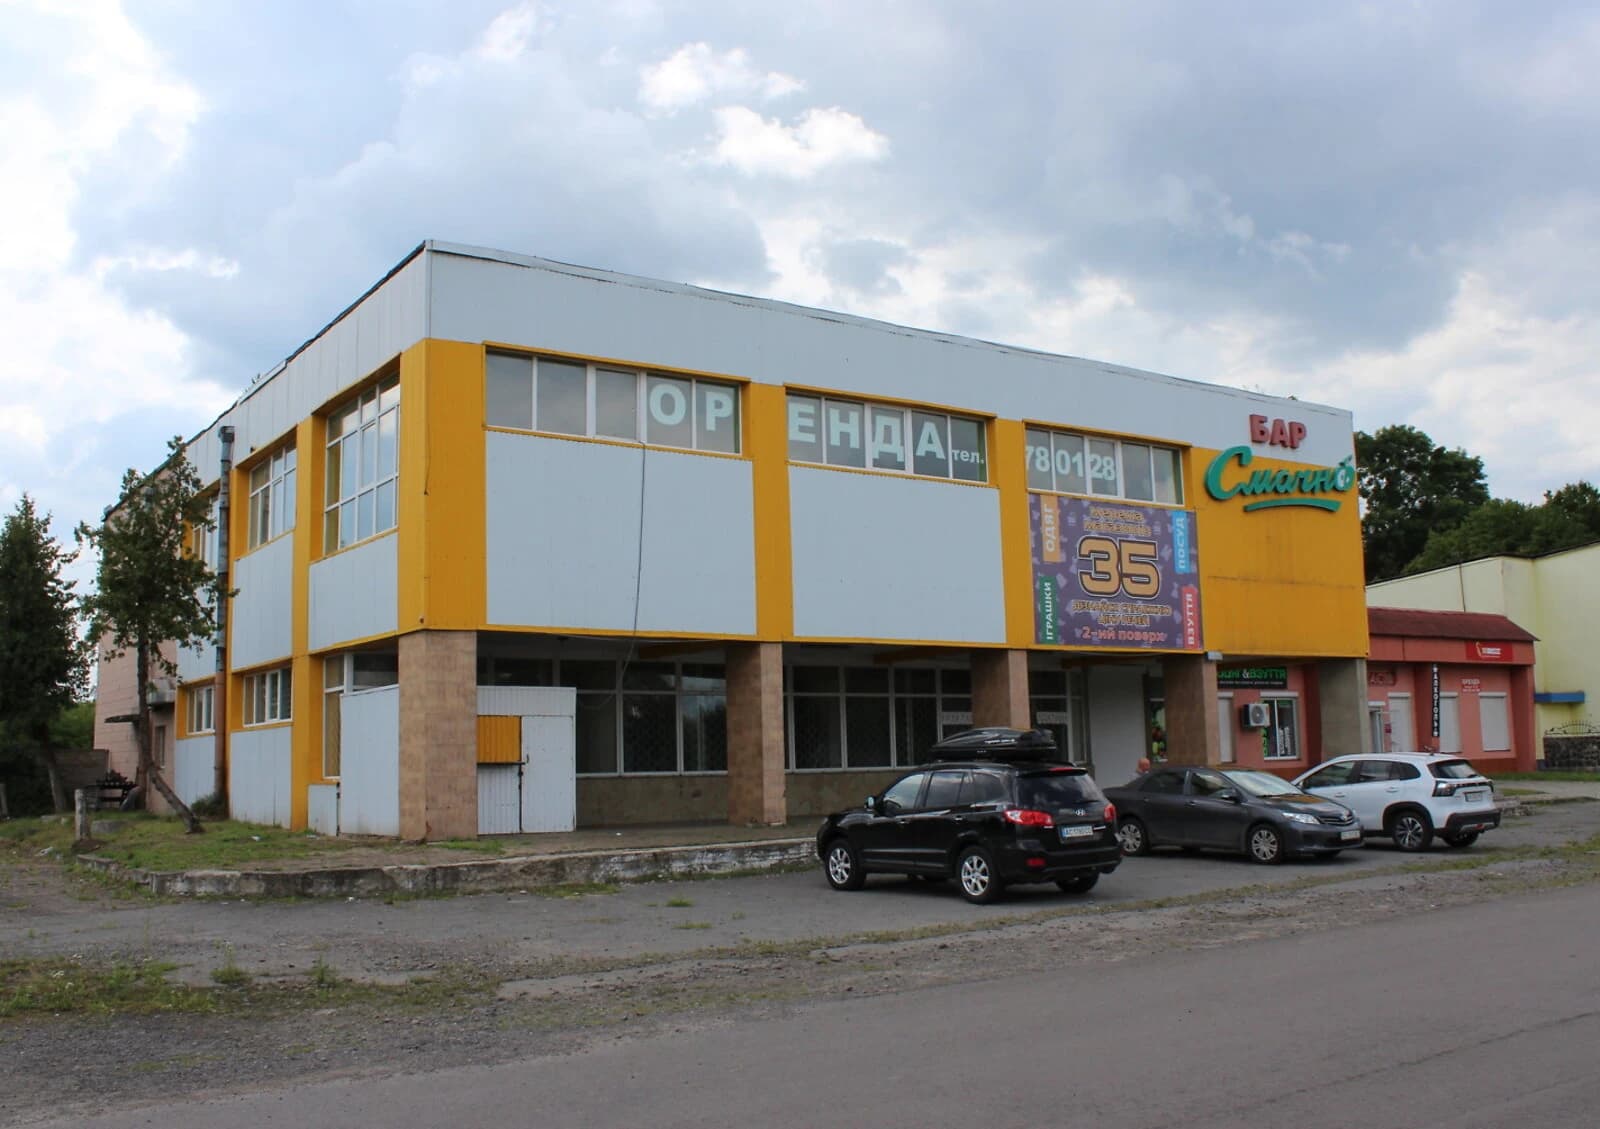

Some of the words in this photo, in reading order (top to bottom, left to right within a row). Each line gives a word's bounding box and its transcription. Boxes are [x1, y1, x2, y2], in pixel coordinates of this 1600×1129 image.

[952, 448, 985, 464] тел.
[1250, 414, 1307, 449] БАР
[1077, 534, 1161, 600] 35
[1176, 517, 1185, 569] ПОСУД
[1044, 582, 1054, 640] ІГРАШКИ
[1186, 593, 1195, 645] ВЗУТТЯ
